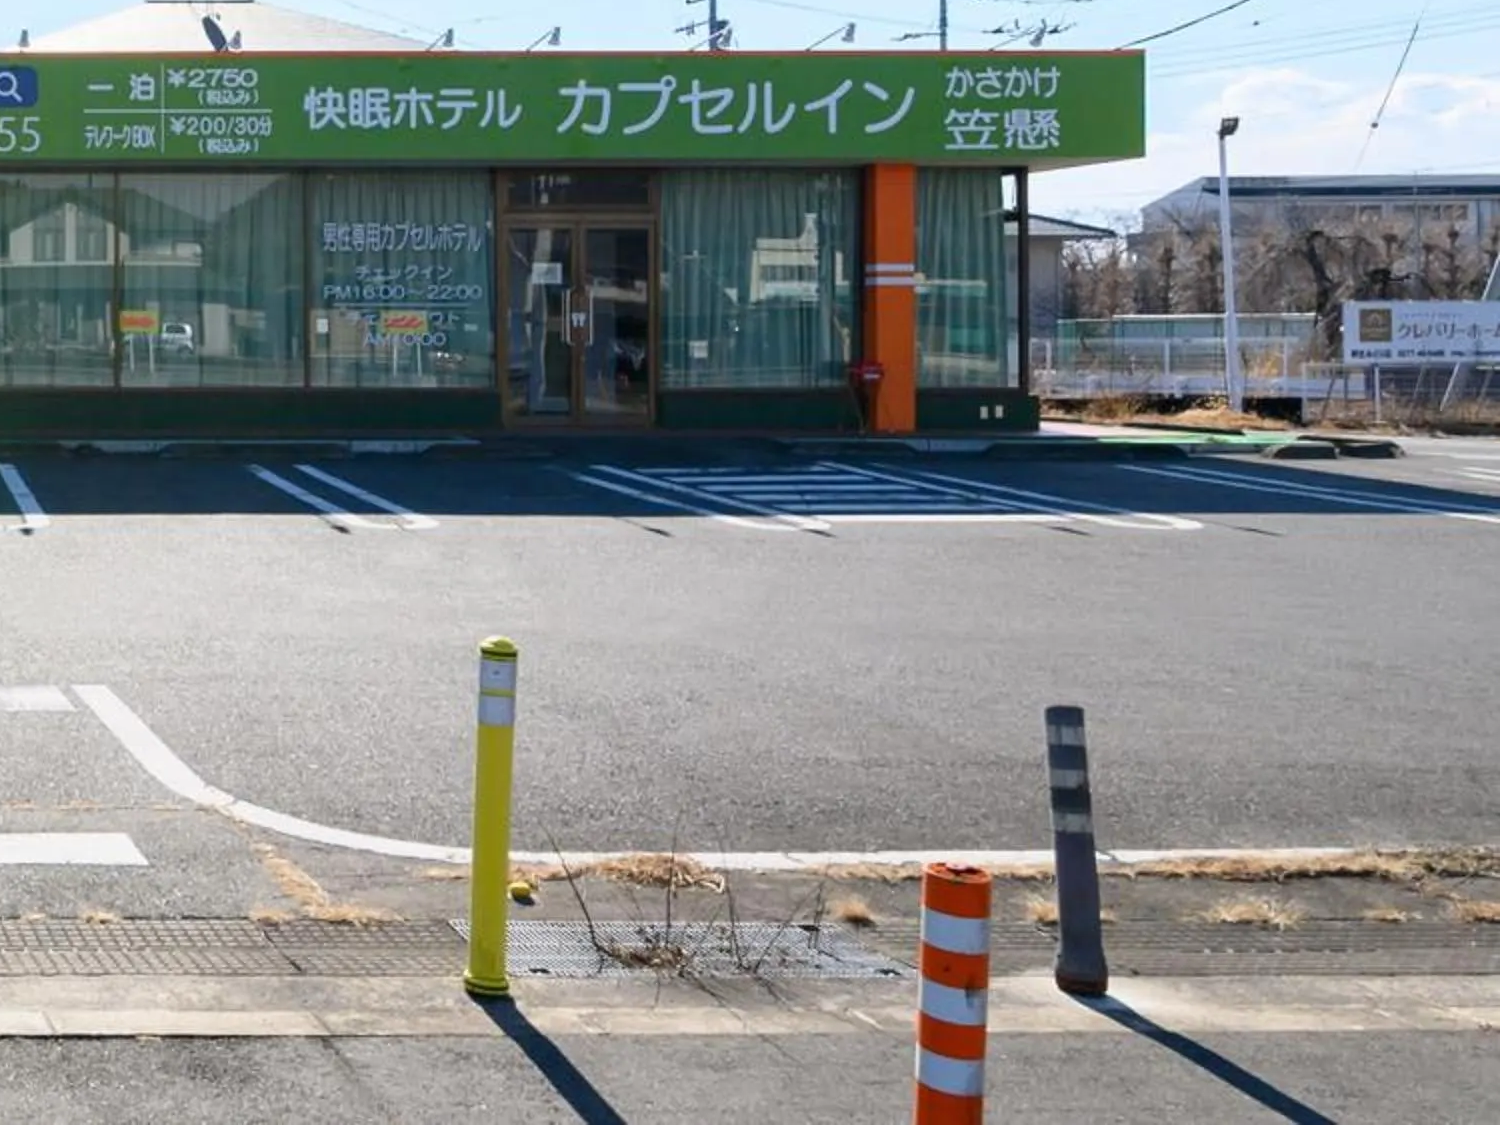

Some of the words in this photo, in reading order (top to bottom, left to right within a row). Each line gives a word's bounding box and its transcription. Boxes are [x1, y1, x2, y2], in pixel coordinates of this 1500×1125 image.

[945, 66, 1060, 98] かさかけ
[303, 86, 522, 130] 快眠ホテル
[556, 75, 916, 135] カプセルイン
[944, 109, 1060, 151] 笠懸
